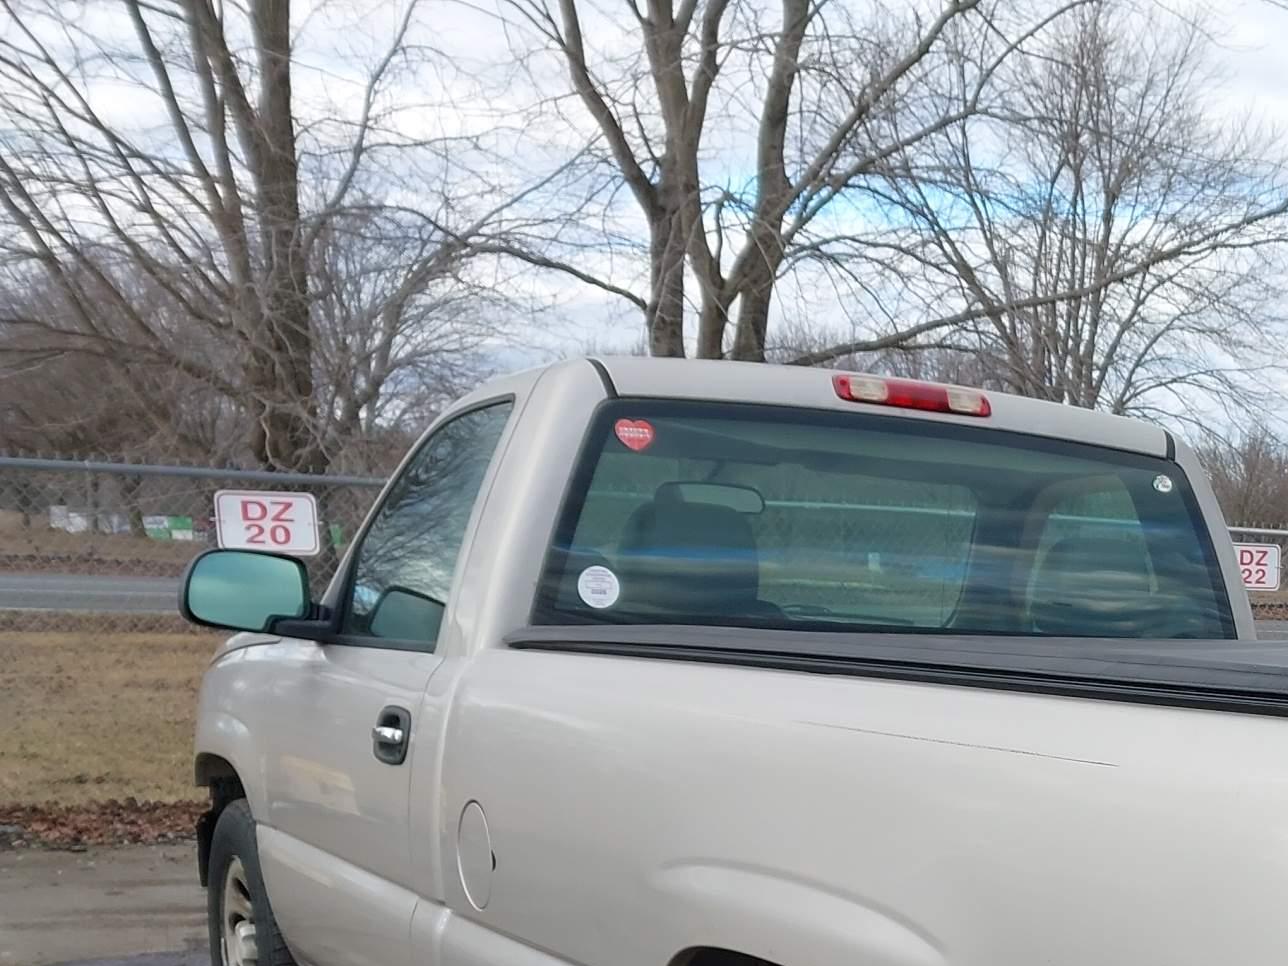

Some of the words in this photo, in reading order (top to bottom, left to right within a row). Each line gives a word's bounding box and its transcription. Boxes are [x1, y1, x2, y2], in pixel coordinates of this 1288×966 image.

[241, 500, 295, 522] DZ
[244, 523, 291, 545] 20
[1240, 549, 1268, 566] DZ
[1241, 568, 1266, 584] 22
